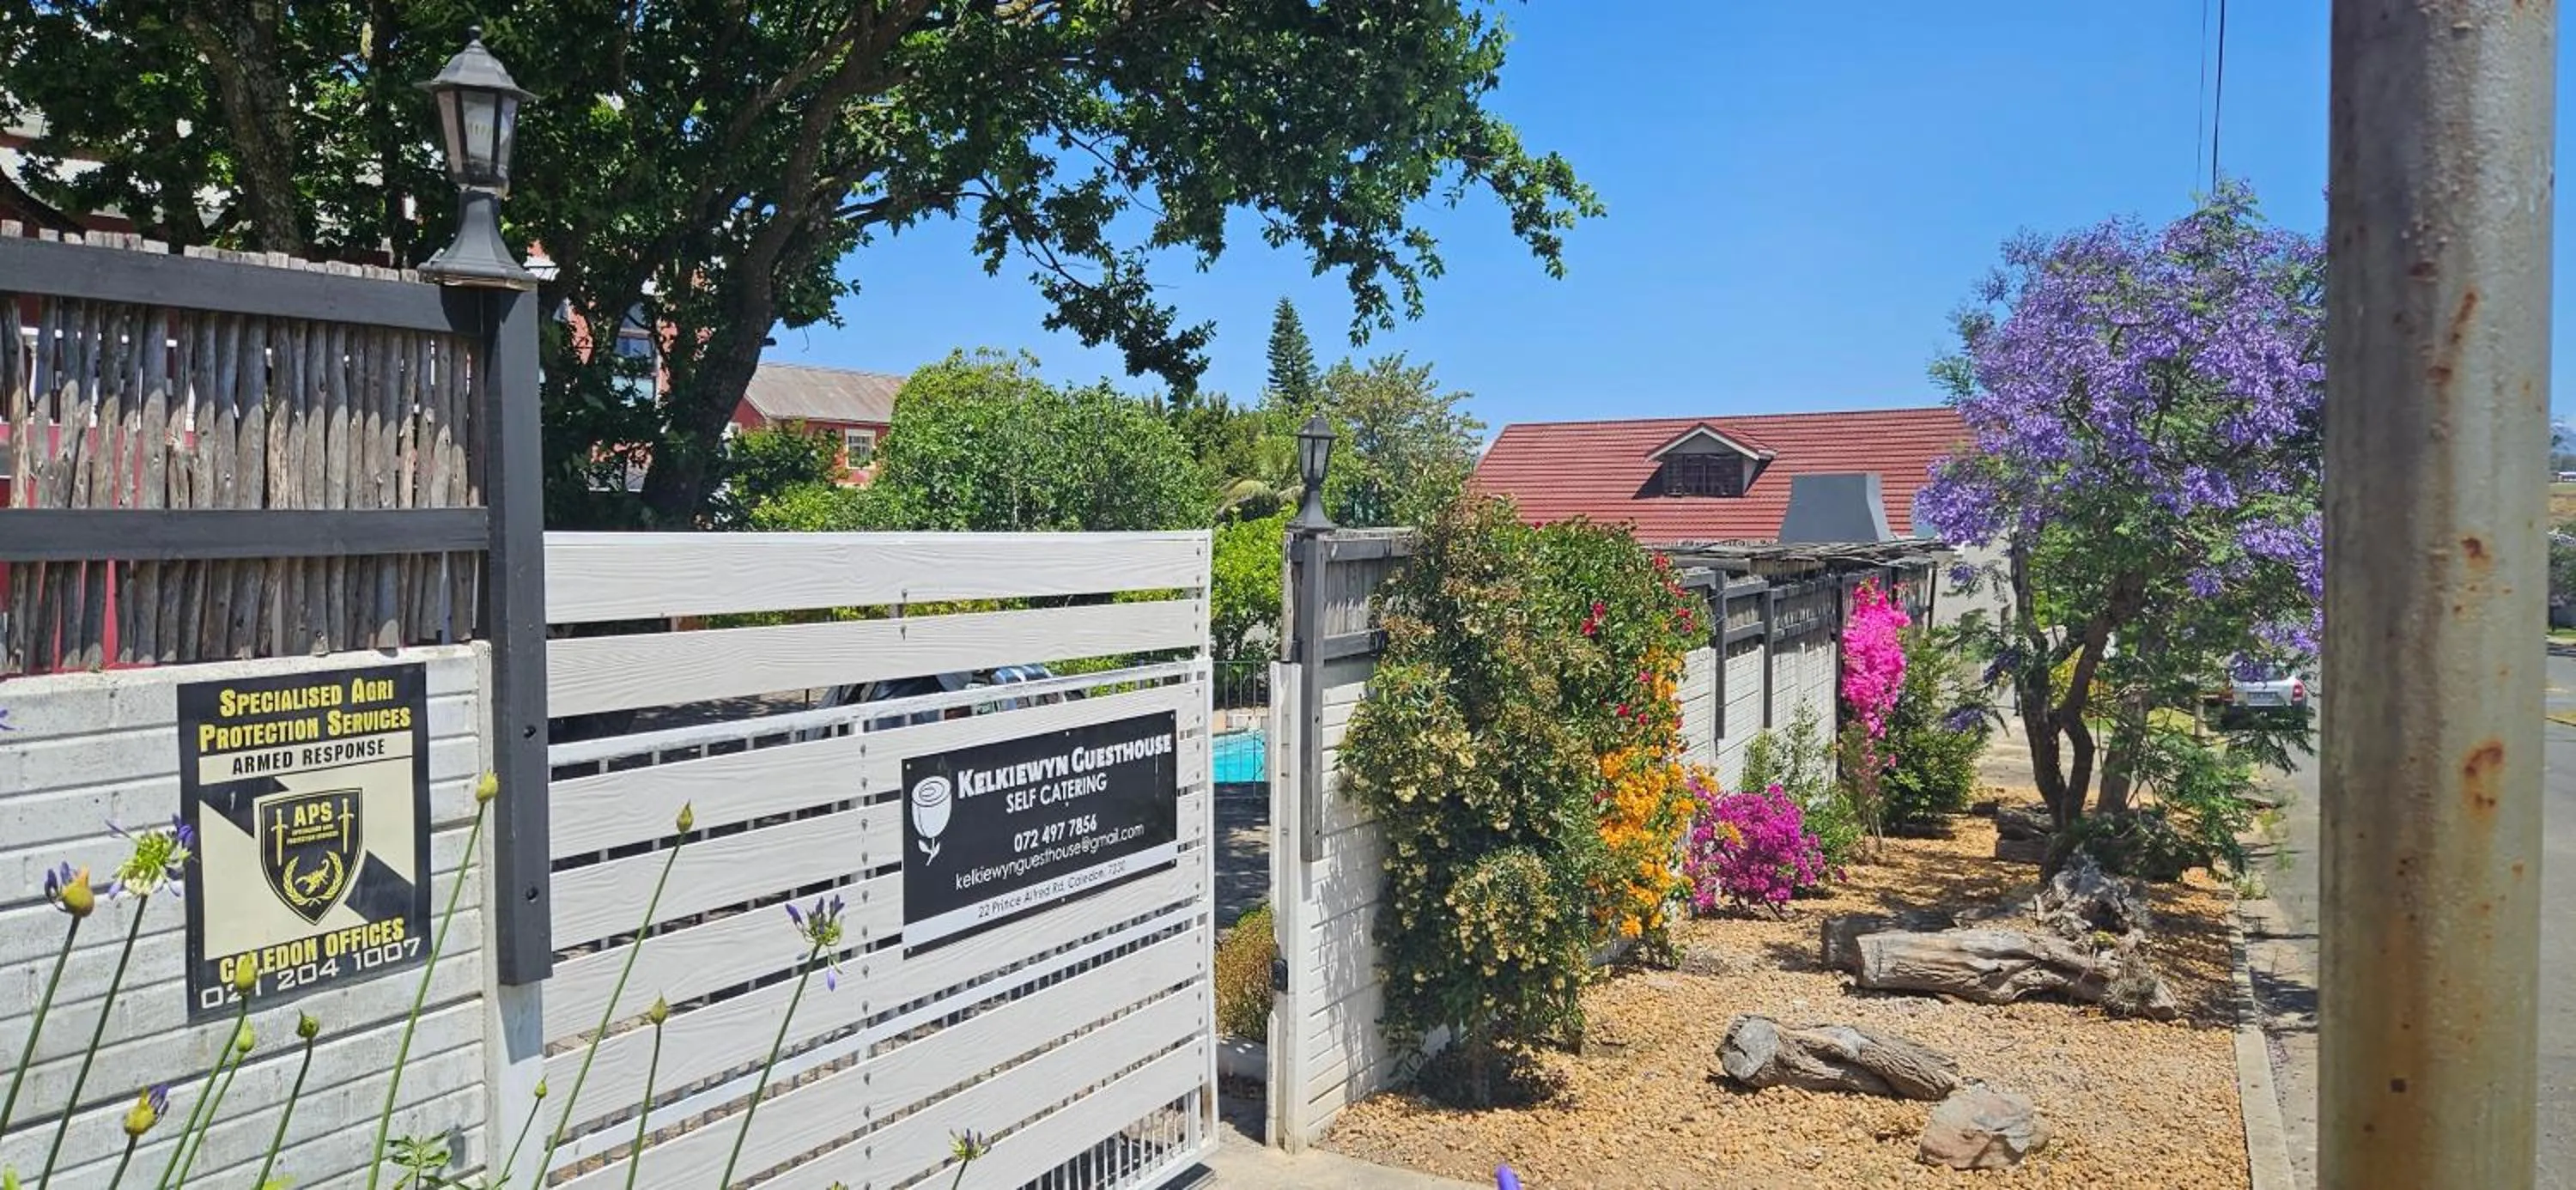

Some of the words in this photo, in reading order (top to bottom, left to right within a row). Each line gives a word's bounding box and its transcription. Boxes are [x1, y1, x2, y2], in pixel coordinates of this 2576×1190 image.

[220, 685, 343, 718] SPECIALISED
[351, 678, 394, 703] AGRI
[198, 716, 319, 752] PROTECTION
[327, 706, 411, 735] SERVICES
[233, 751, 293, 774] ARMED
[302, 738, 385, 766] RESPONSE
[957, 755, 1069, 798] KELKIEWYN
[1071, 733, 1172, 773] GUESTHOUSE
[1005, 787, 1036, 813] SELF
[1039, 772, 1107, 806] CATERING
[293, 801, 332, 827] APS
[1014, 829, 1039, 853] 072
[1042, 821, 1066, 844] 497
[1067, 814, 1097, 837] 7856
[955, 823, 1145, 891] kelkiewynguesthouse@gmail.com
[992, 896, 1022, 914] Prince
[325, 917, 404, 957] OFFICES
[276, 958, 340, 992] 204
[352, 937, 422, 971] 1007
